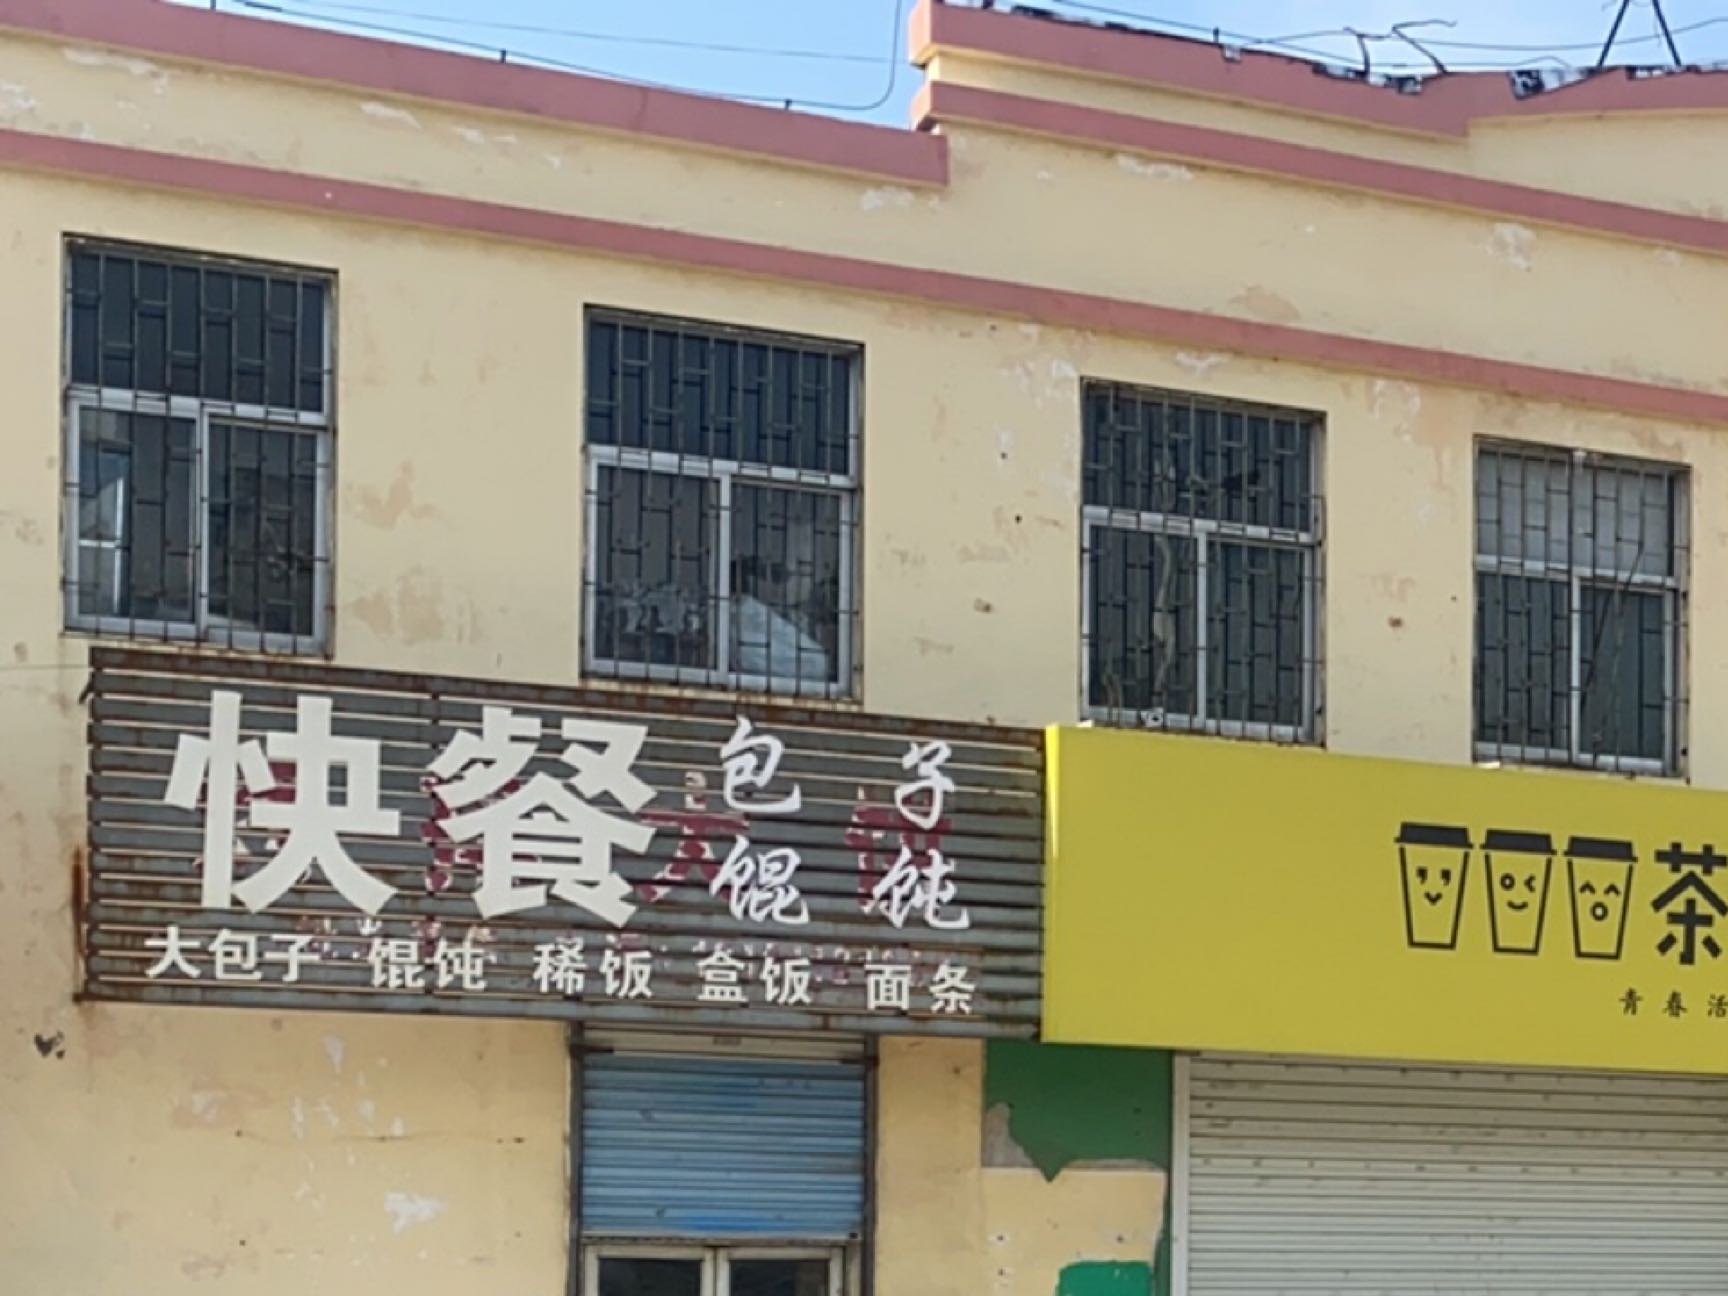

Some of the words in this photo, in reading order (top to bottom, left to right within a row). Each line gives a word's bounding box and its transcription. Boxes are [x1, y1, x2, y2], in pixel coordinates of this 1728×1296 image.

[164, 690, 657, 928] 快餐
[720, 715, 955, 829] 包子
[709, 835, 970, 929] 馄饨
[144, 925, 320, 982] 大包子
[367, 927, 487, 990] 馄饨
[532, 936, 653, 998] 稀饭
[697, 951, 813, 1005] 盒饭
[864, 959, 976, 1014] 面条
